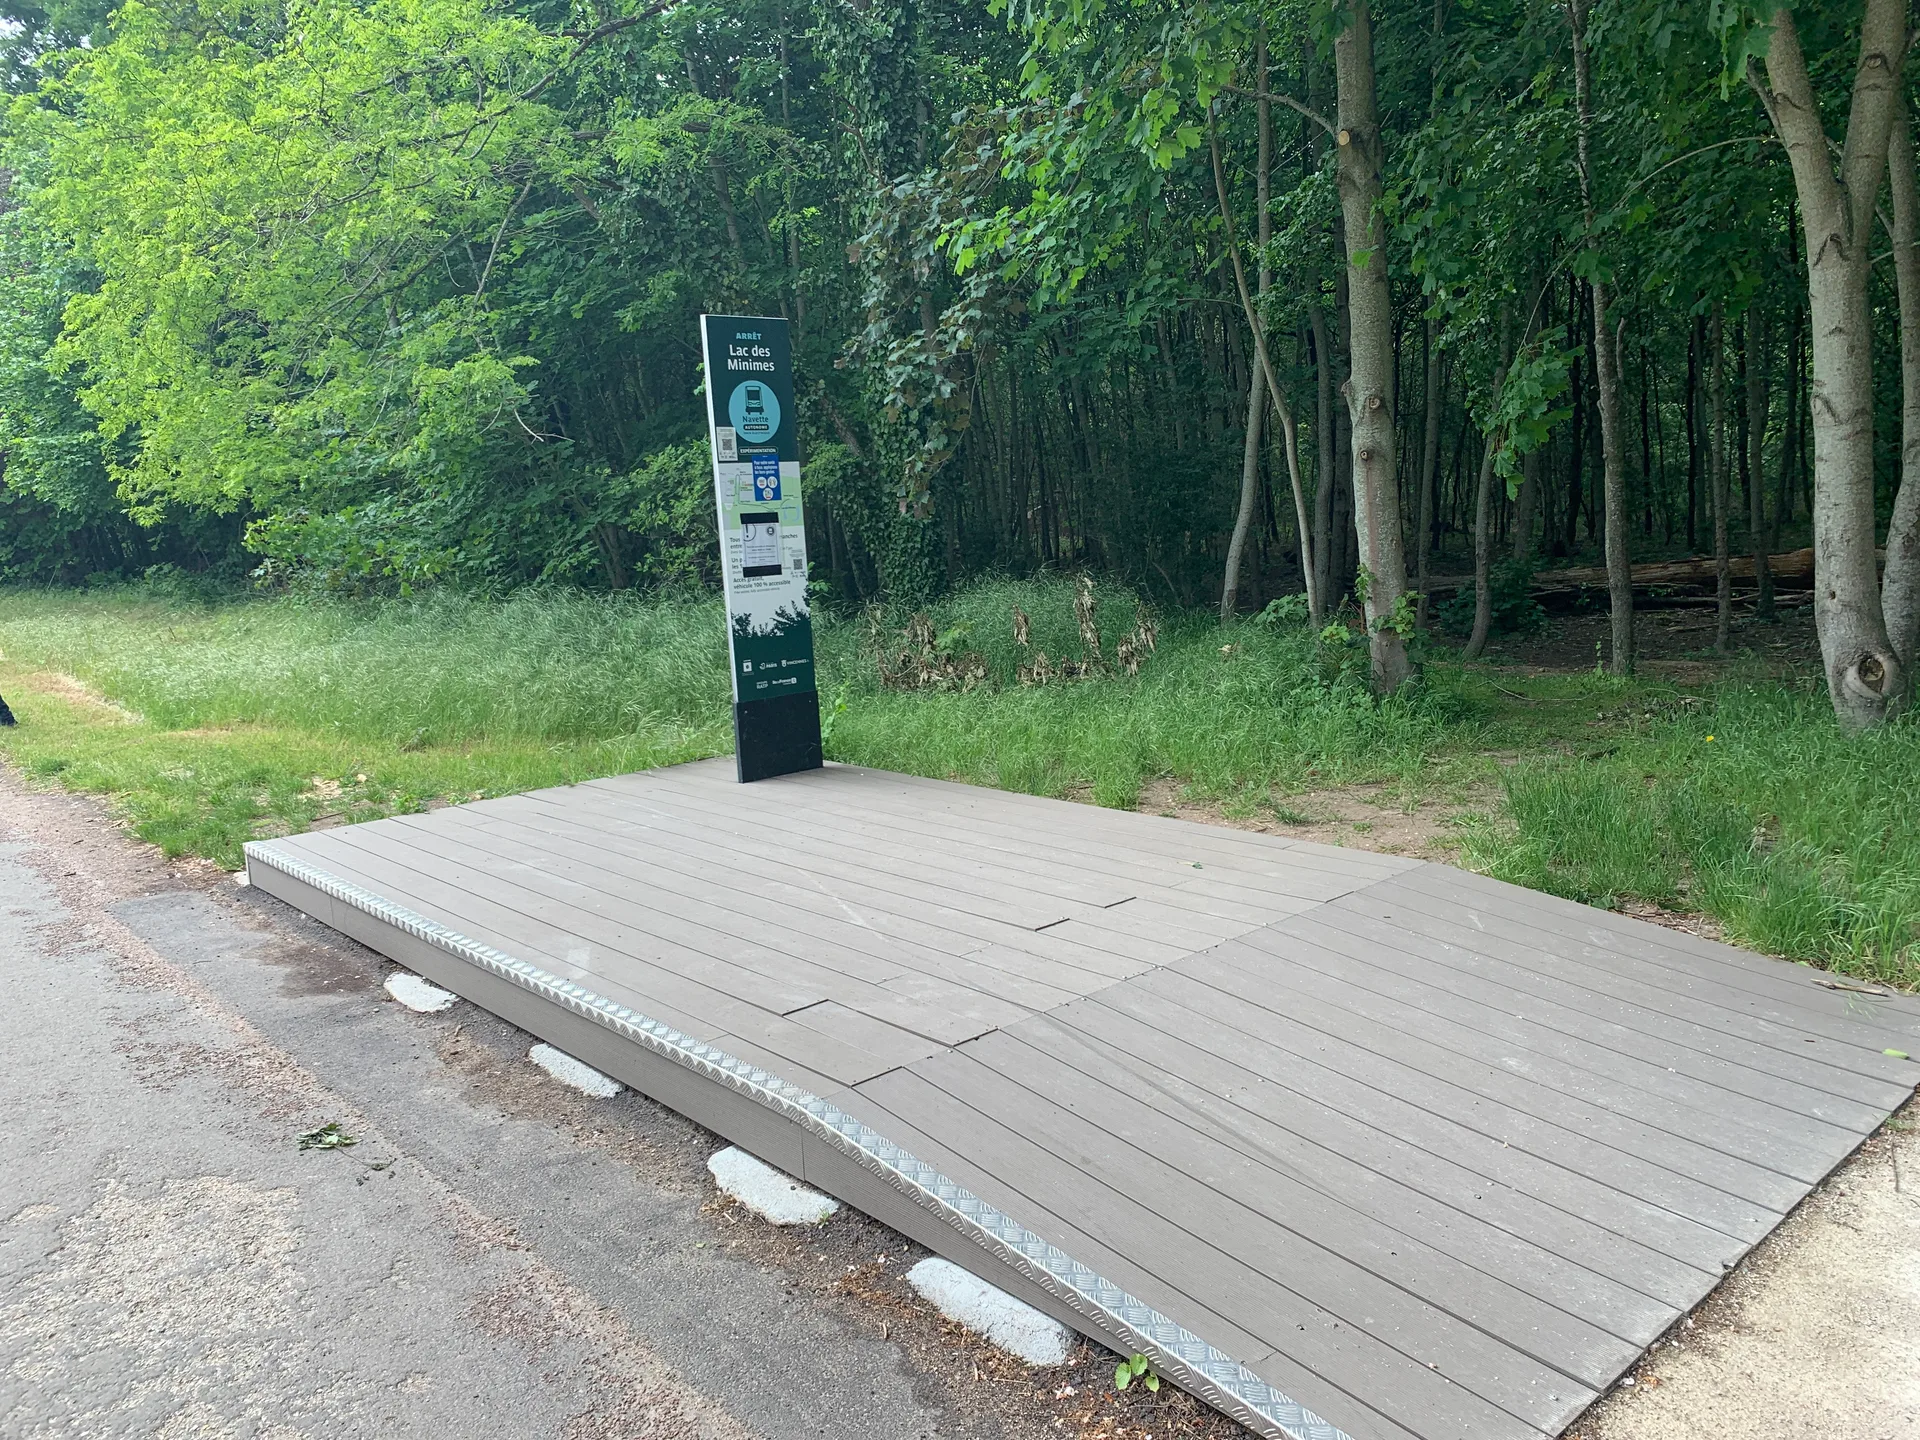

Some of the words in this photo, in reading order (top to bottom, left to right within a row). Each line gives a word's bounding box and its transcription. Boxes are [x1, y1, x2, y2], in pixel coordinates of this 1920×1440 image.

[736, 332, 762, 340] ARRÊT
[729, 344, 749, 356] Lac
[751, 345, 771, 357] des
[727, 358, 775, 372] Minimes
[733, 582, 753, 590] véhicule
[769, 579, 791, 587] accessible
